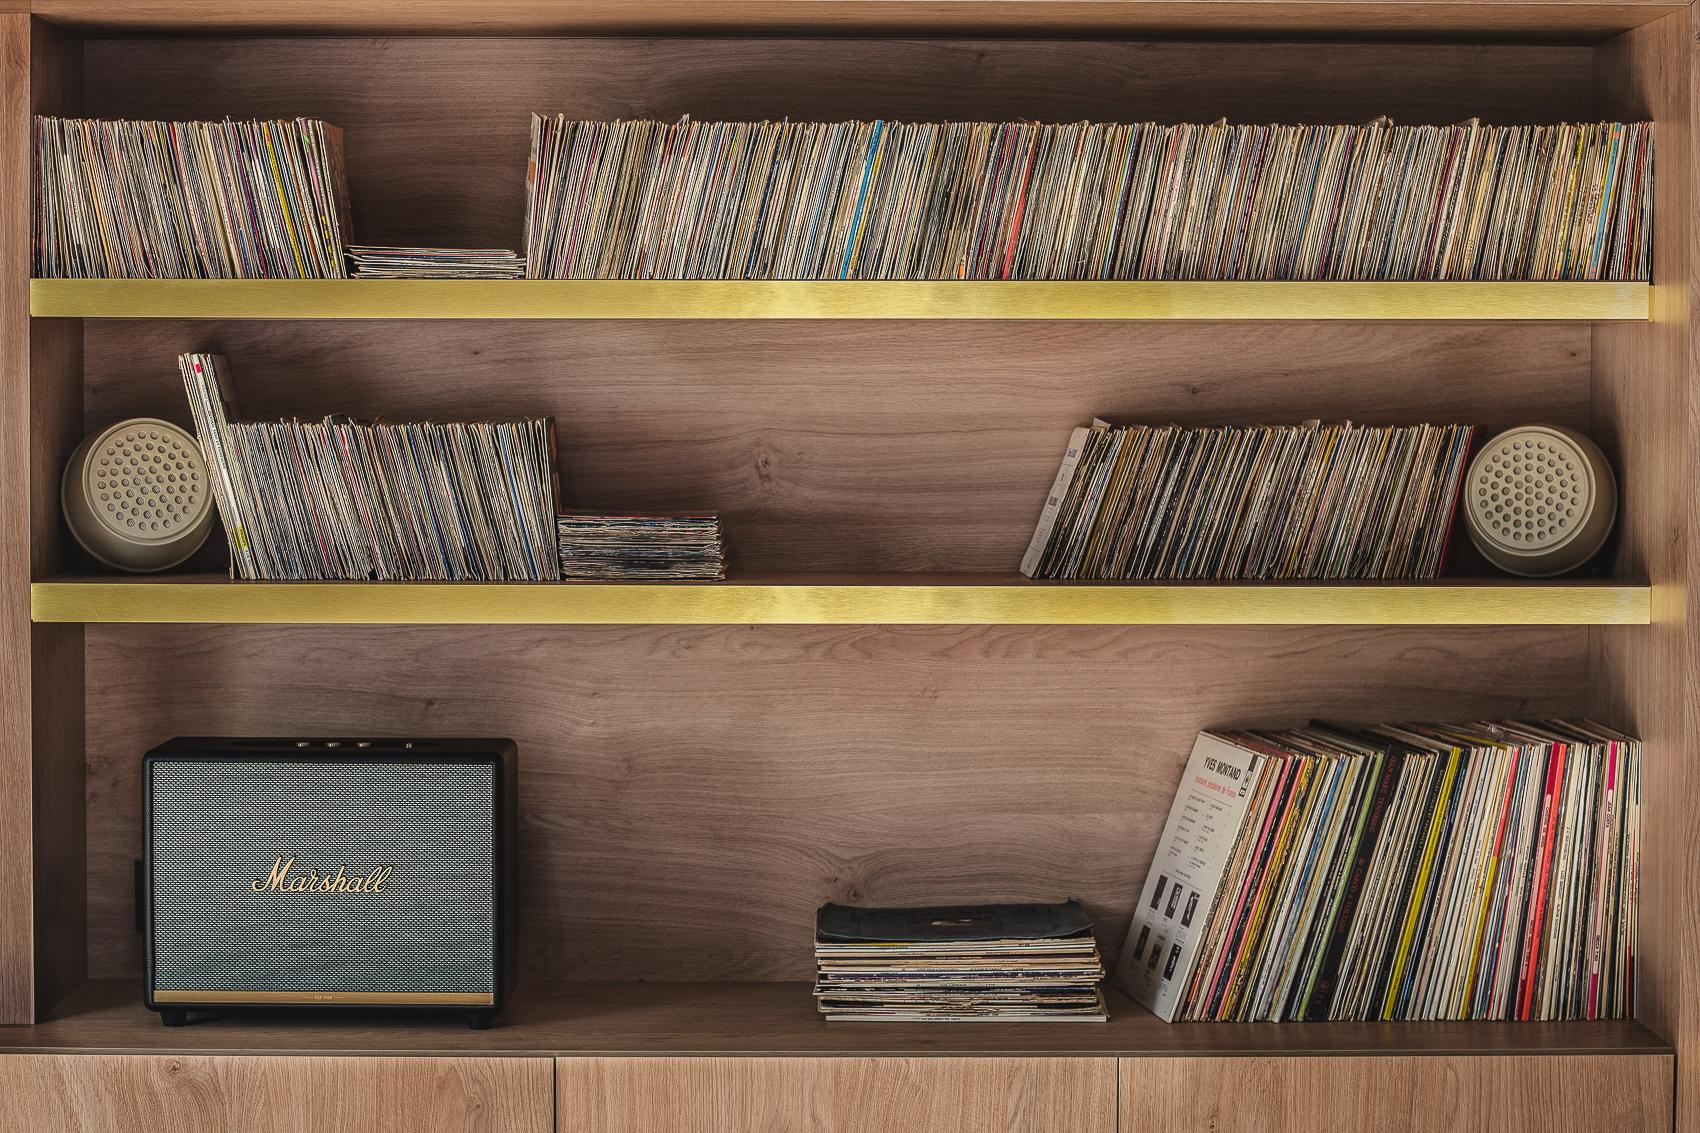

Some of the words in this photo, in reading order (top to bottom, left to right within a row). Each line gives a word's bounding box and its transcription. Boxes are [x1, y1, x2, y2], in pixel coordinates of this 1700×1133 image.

[1204, 756, 1217, 770] YVES
[1216, 762, 1241, 780] MONTAND
[252, 856, 392, 894] Marshall
